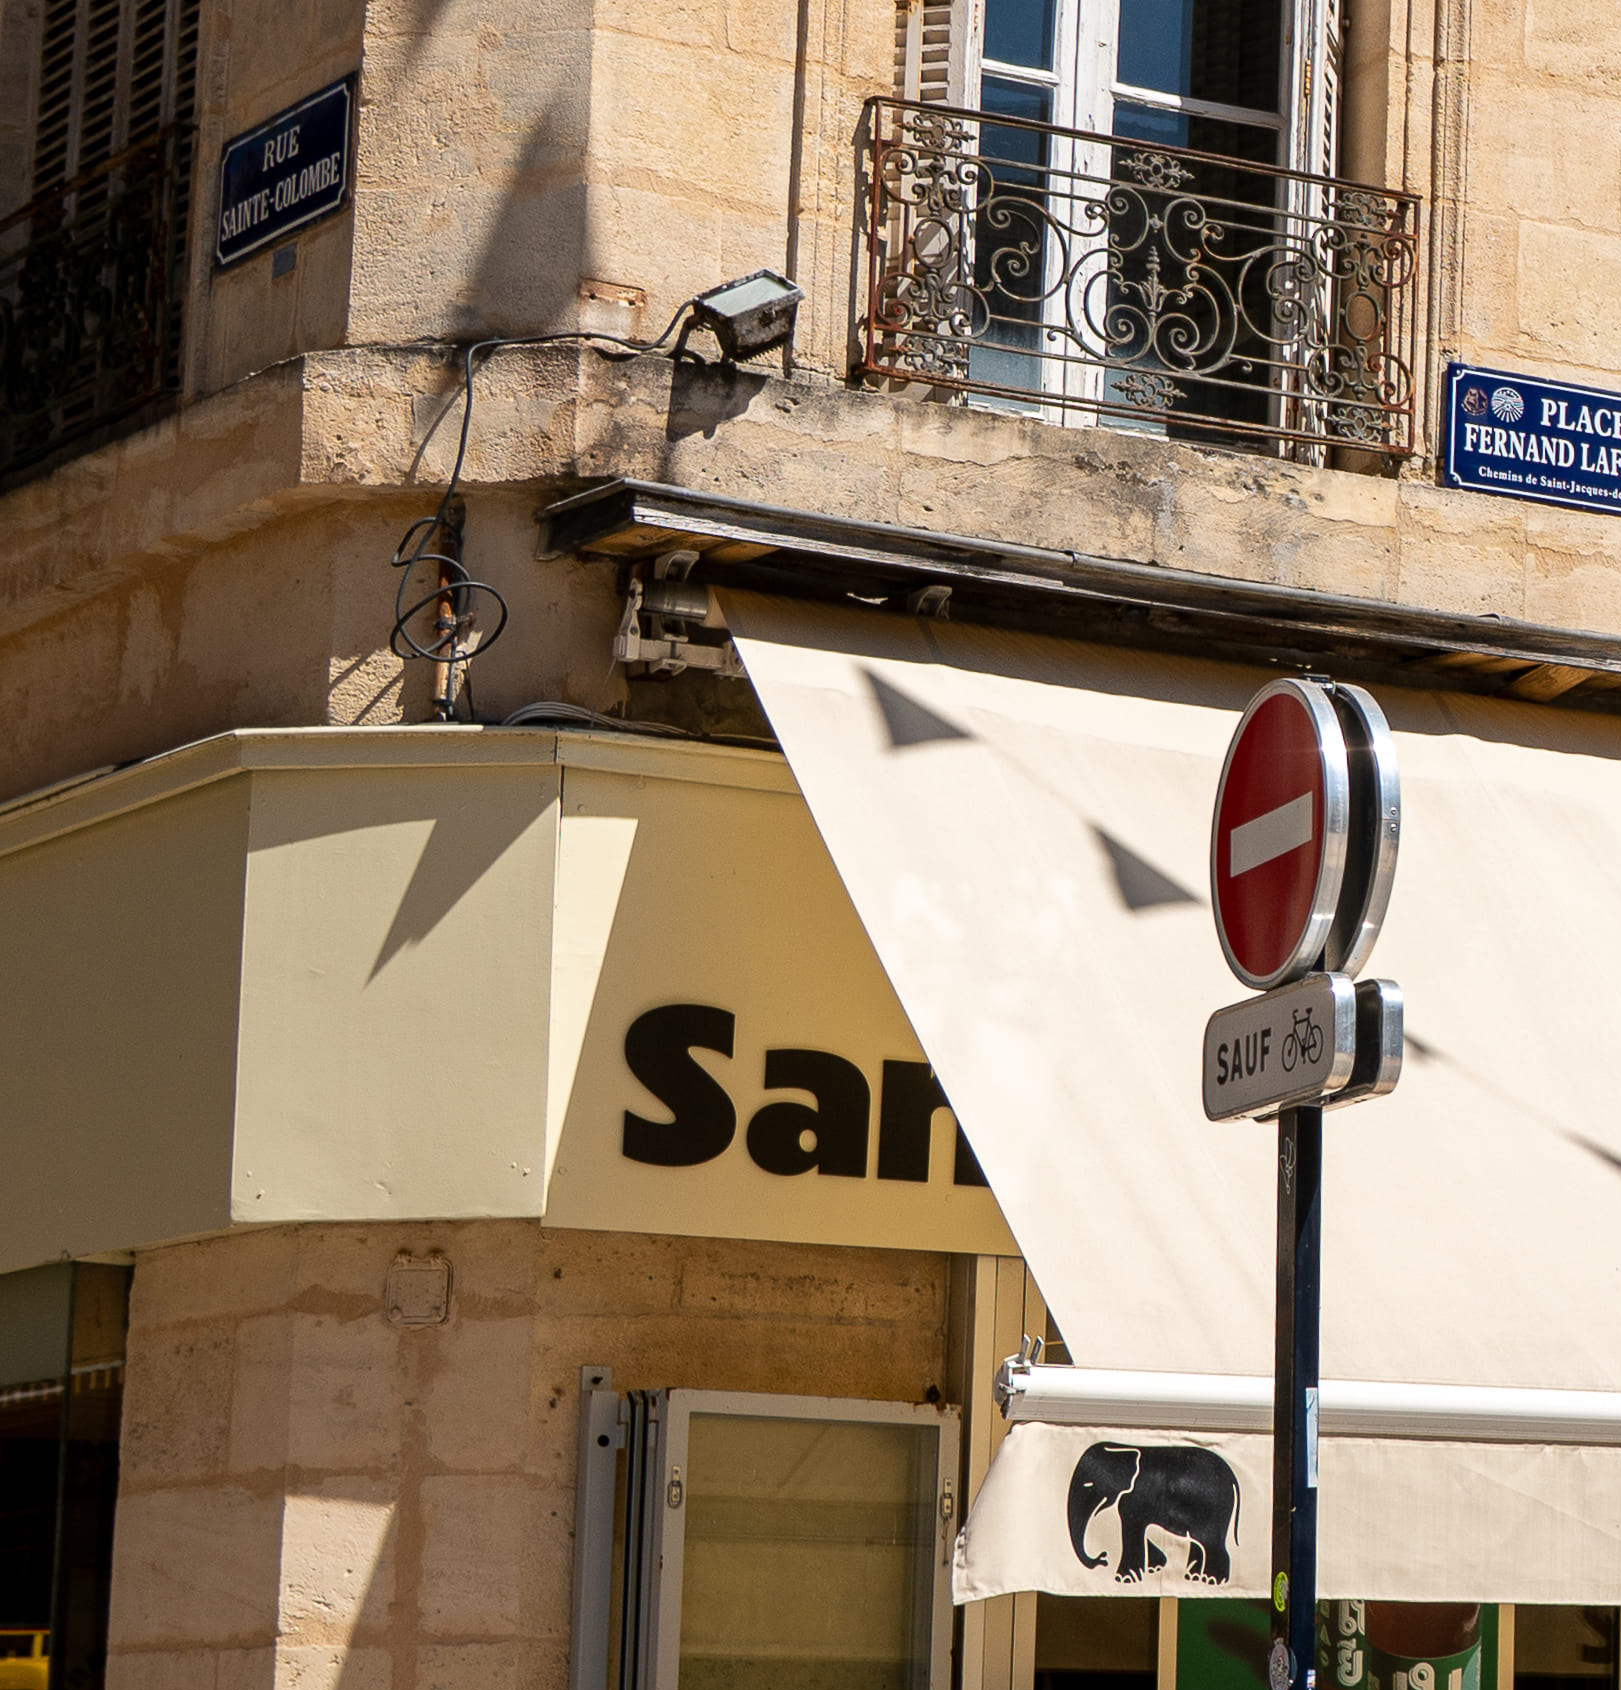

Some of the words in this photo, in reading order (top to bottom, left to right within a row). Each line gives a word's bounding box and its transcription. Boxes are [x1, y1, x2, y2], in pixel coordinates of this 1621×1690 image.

[262, 124, 300, 172] RUE
[221, 152, 341, 242] SAINTE-COLOMBE
[1463, 422, 1575, 468] FERNAND
[1478, 466, 1523, 484] Chemins
[1526, 473, 1538, 486] de
[1216, 1026, 1272, 1087] SAUF
